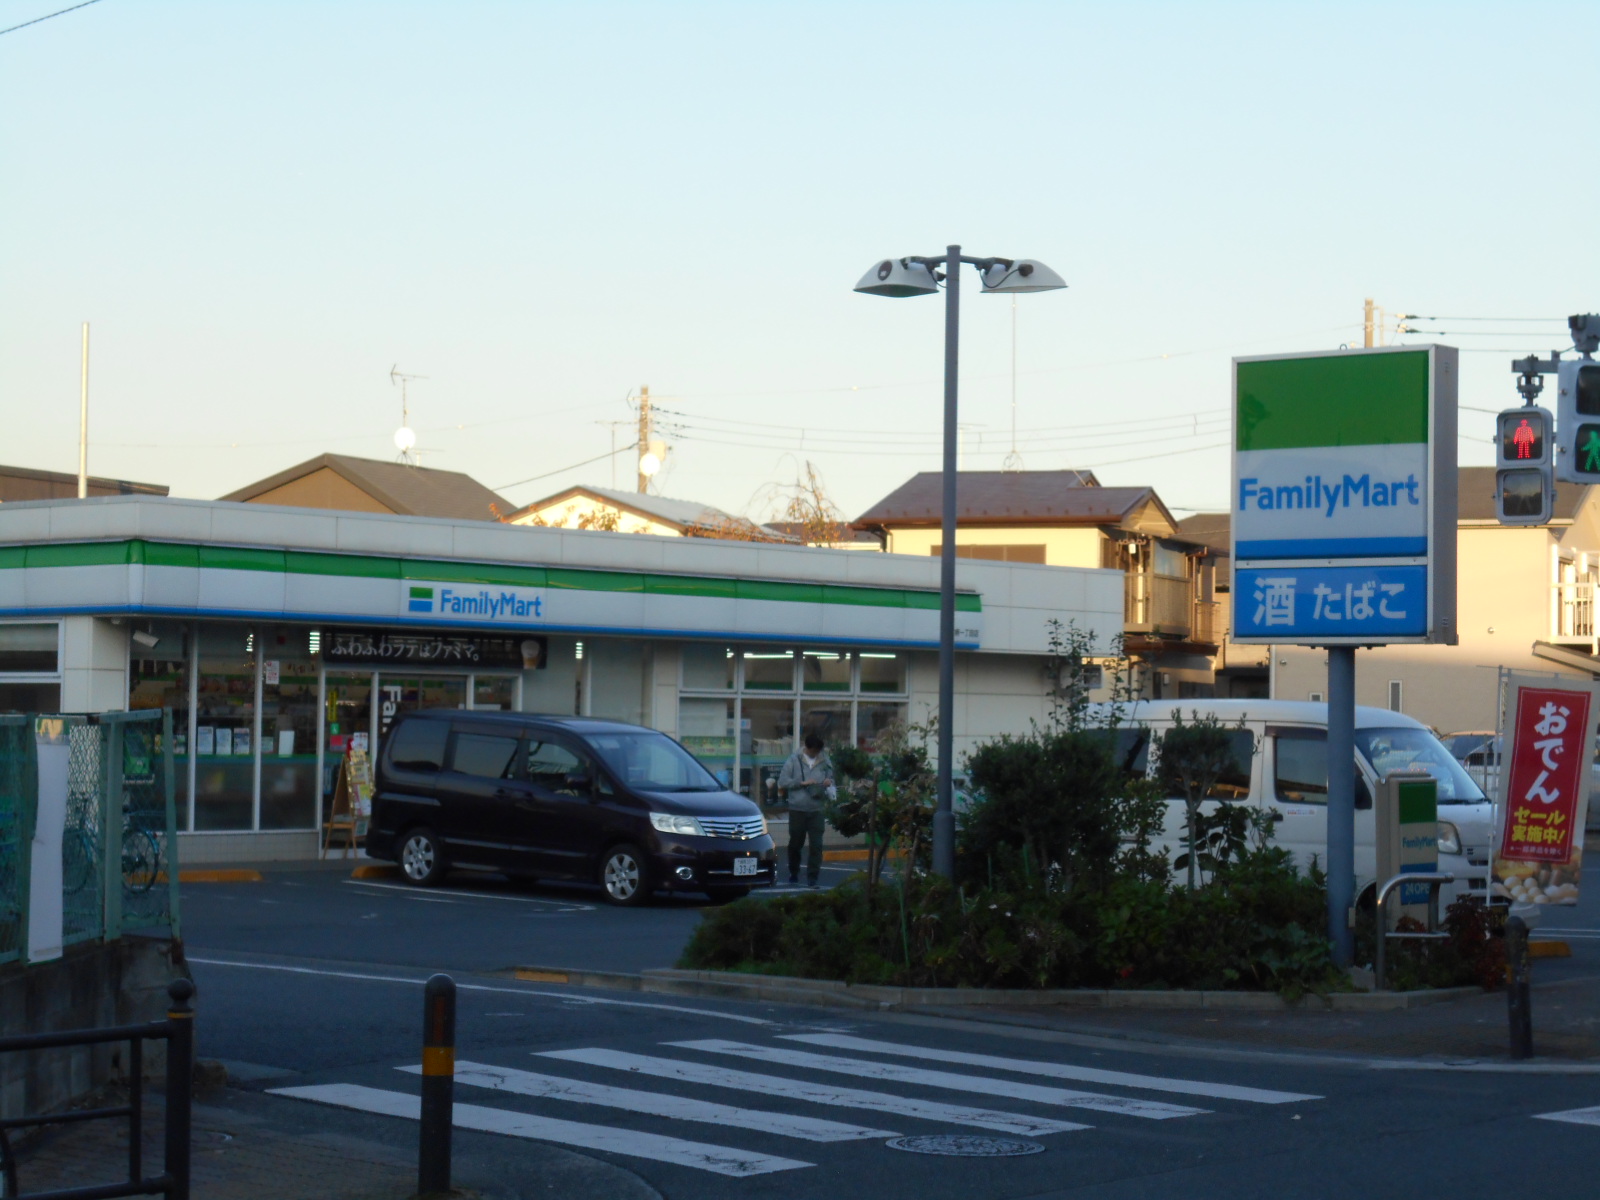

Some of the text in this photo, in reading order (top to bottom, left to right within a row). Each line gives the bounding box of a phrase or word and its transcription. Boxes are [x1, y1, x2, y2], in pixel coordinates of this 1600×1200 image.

[1239, 474, 1419, 518] FamilyMart
[440, 589, 541, 618] FamilyMart
[1252, 577, 1407, 626] 酒 たばこ
[1525, 701, 1571, 805] おでん
[1513, 806, 1565, 825] セール
[1512, 826, 1567, 845] 実施中!
